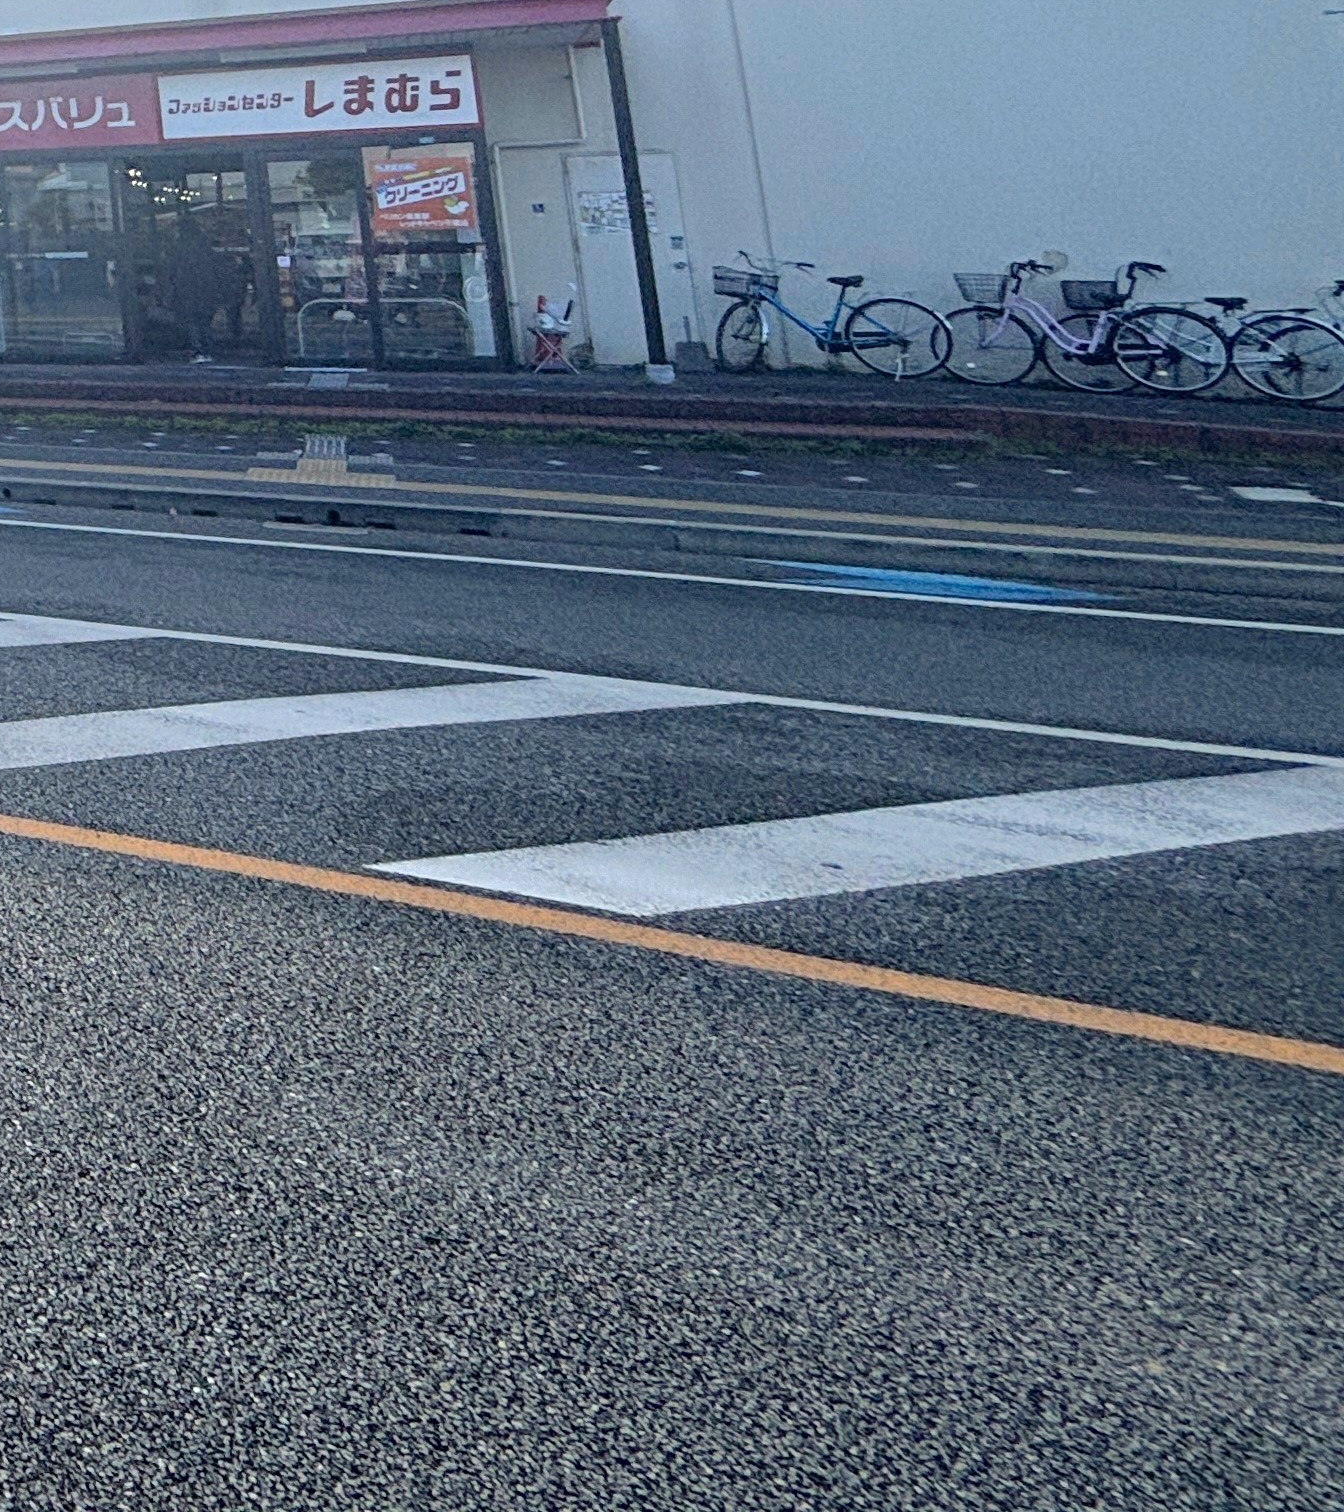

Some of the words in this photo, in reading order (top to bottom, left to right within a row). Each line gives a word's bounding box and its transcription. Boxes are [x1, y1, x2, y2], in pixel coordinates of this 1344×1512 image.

[167, 91, 296, 117] ファッションセンター
[303, 69, 463, 119] しまむら
[385, 178, 459, 205] クリーニング
